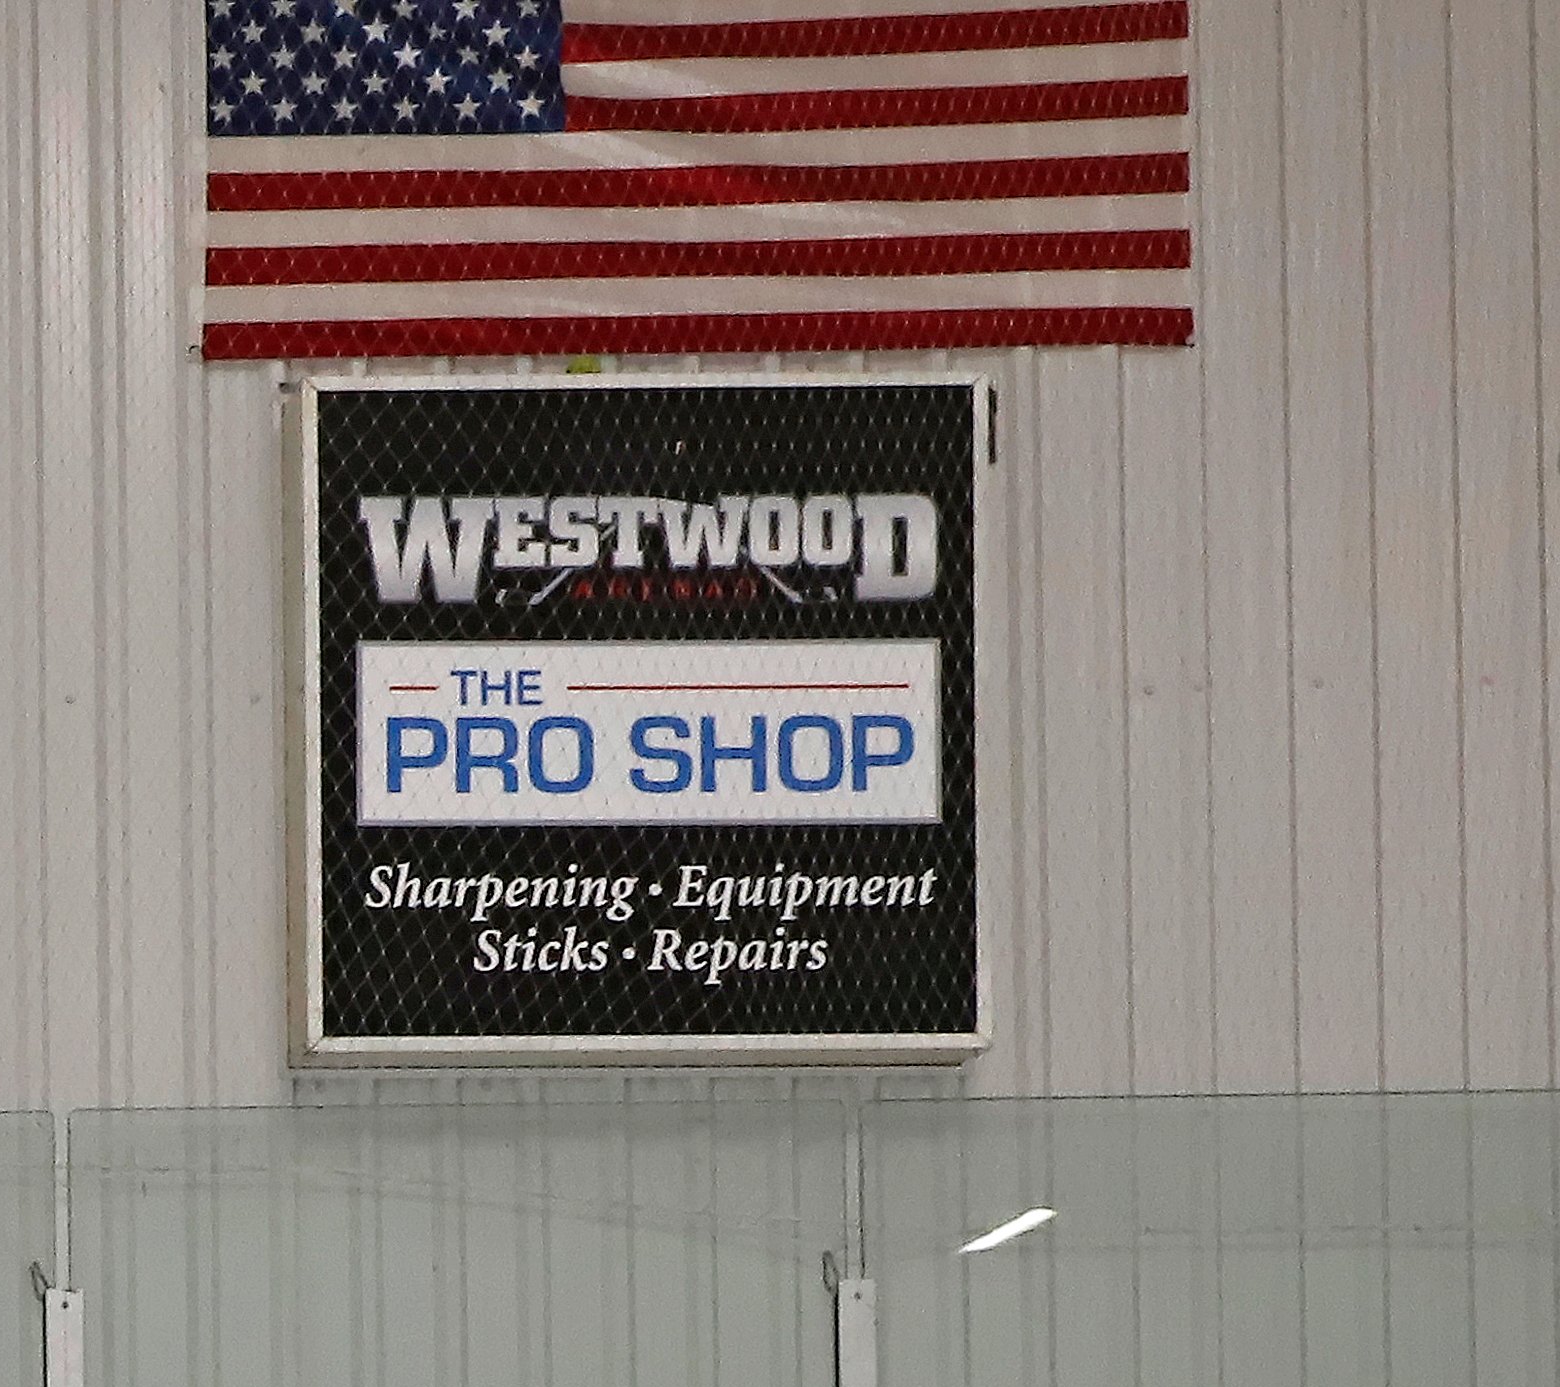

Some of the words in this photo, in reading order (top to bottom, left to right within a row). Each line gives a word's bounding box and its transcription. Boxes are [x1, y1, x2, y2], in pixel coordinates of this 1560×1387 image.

[358, 495, 937, 603] WESTWOOD
[450, 670, 543, 706] THE
[386, 715, 595, 794] PRO
[628, 715, 916, 794] SHOP
[366, 865, 639, 920] Sharpening
[673, 865, 937, 925] Equipment
[473, 927, 609, 972] Sticks
[648, 930, 829, 984] Repairs
